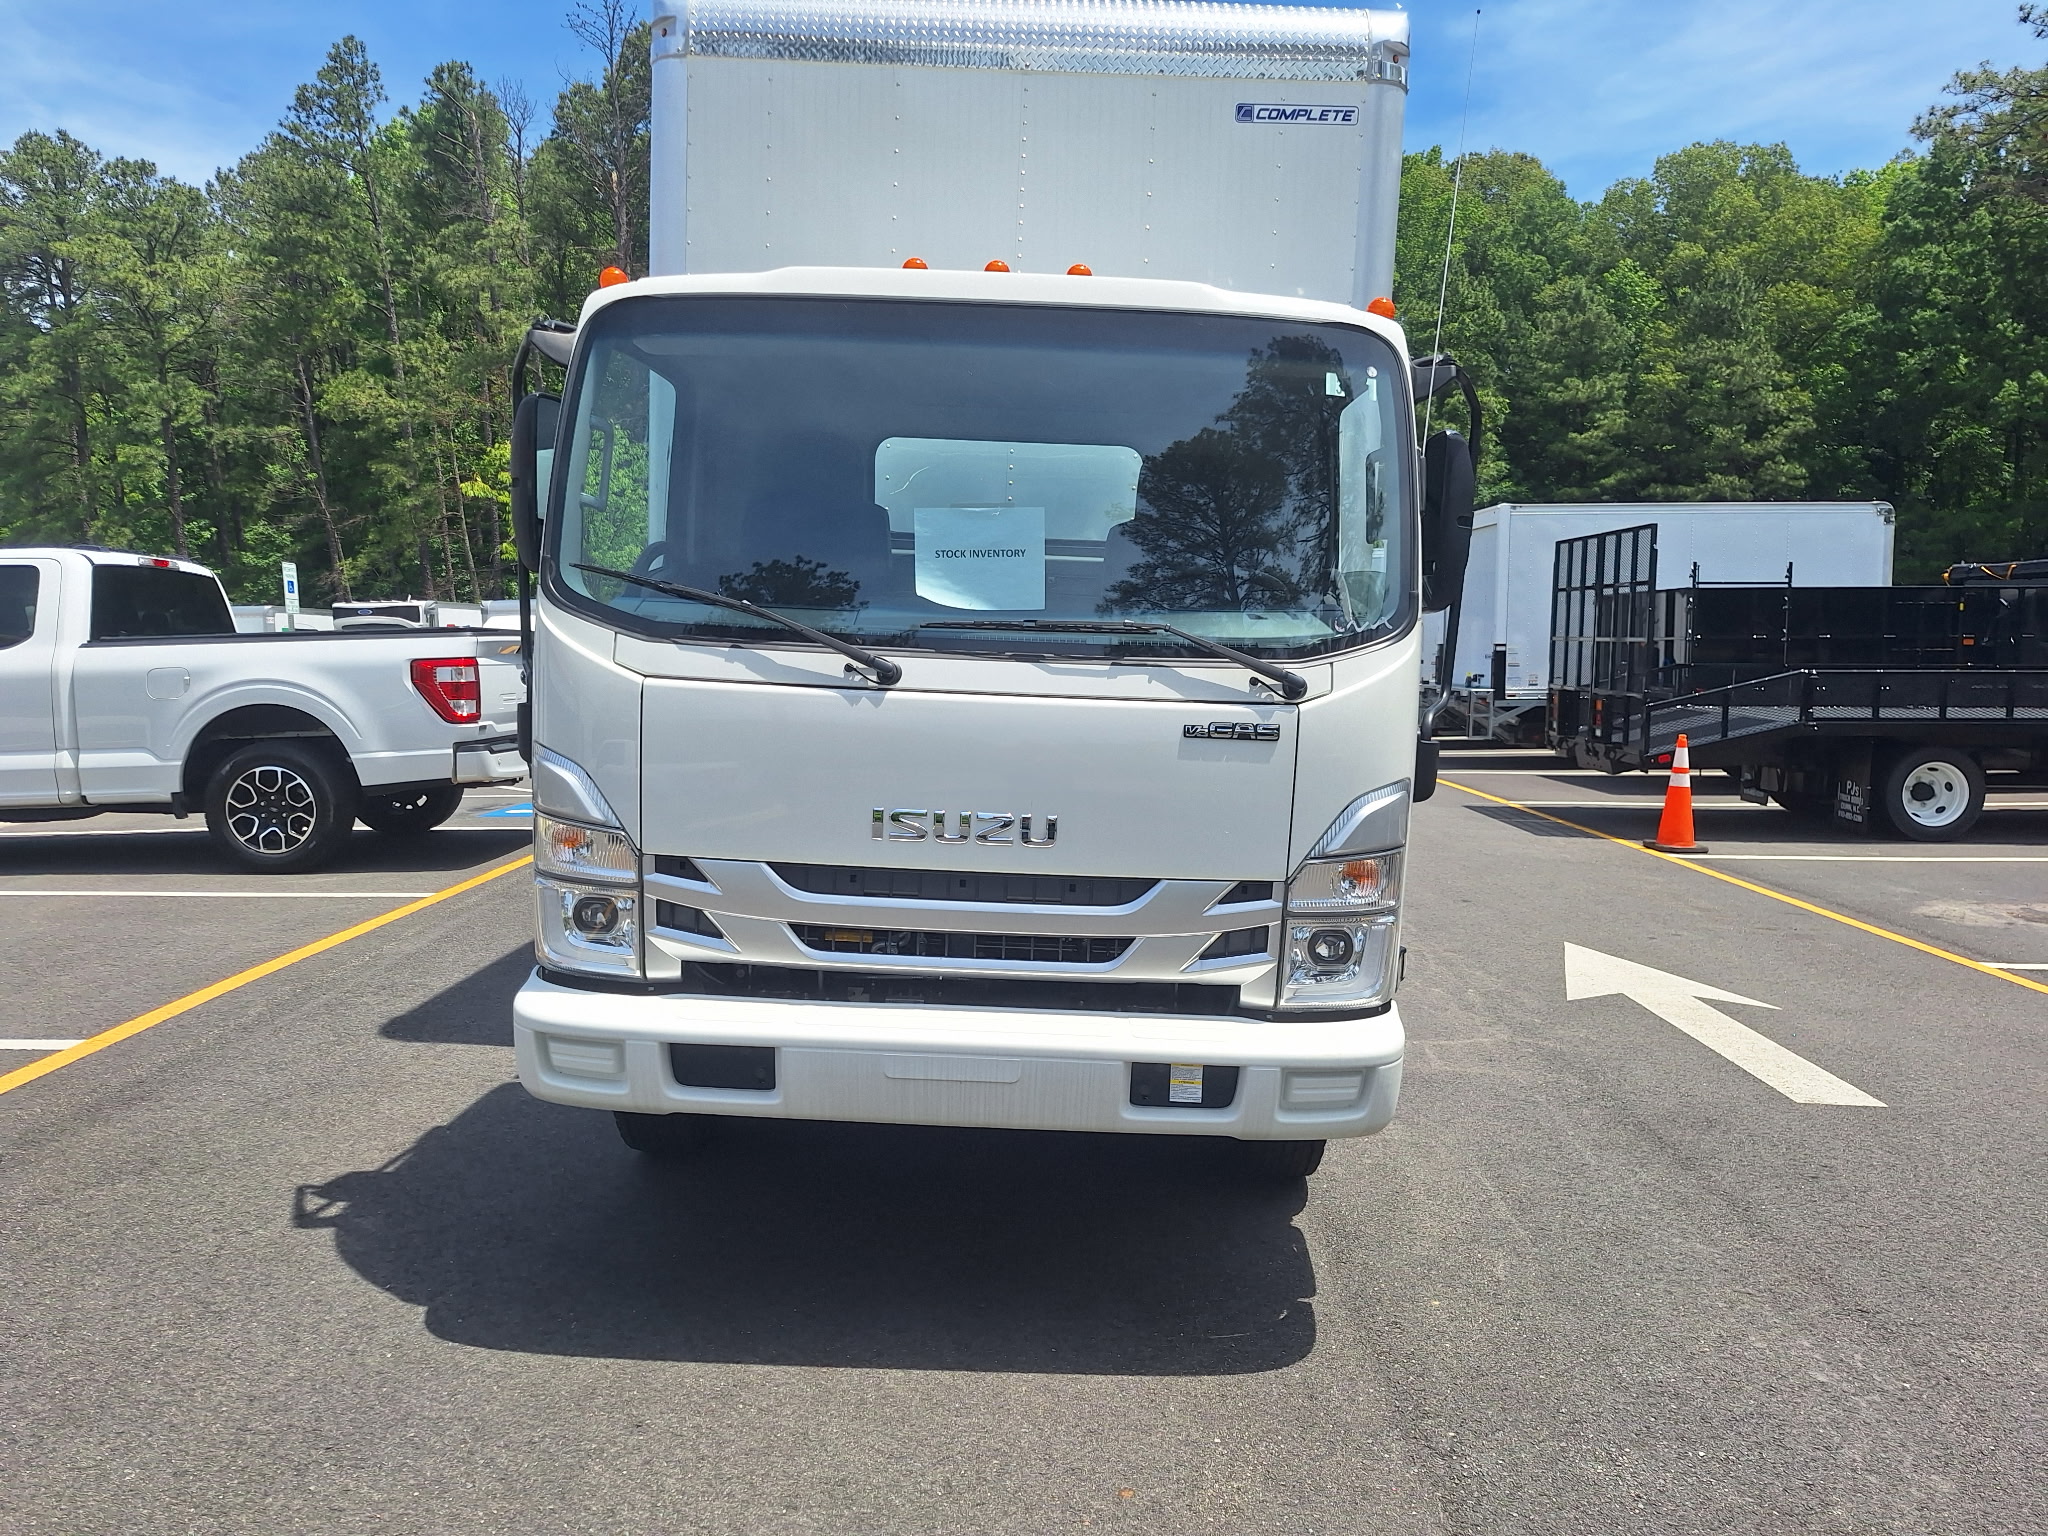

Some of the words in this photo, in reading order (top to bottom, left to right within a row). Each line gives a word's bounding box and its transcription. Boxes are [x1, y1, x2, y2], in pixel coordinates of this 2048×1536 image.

[1256, 108, 1355, 122] COMPLETE
[935, 549, 967, 559] STOCK
[969, 548, 1026, 558] INVENTORY
[872, 807, 1058, 848] ISUZU
